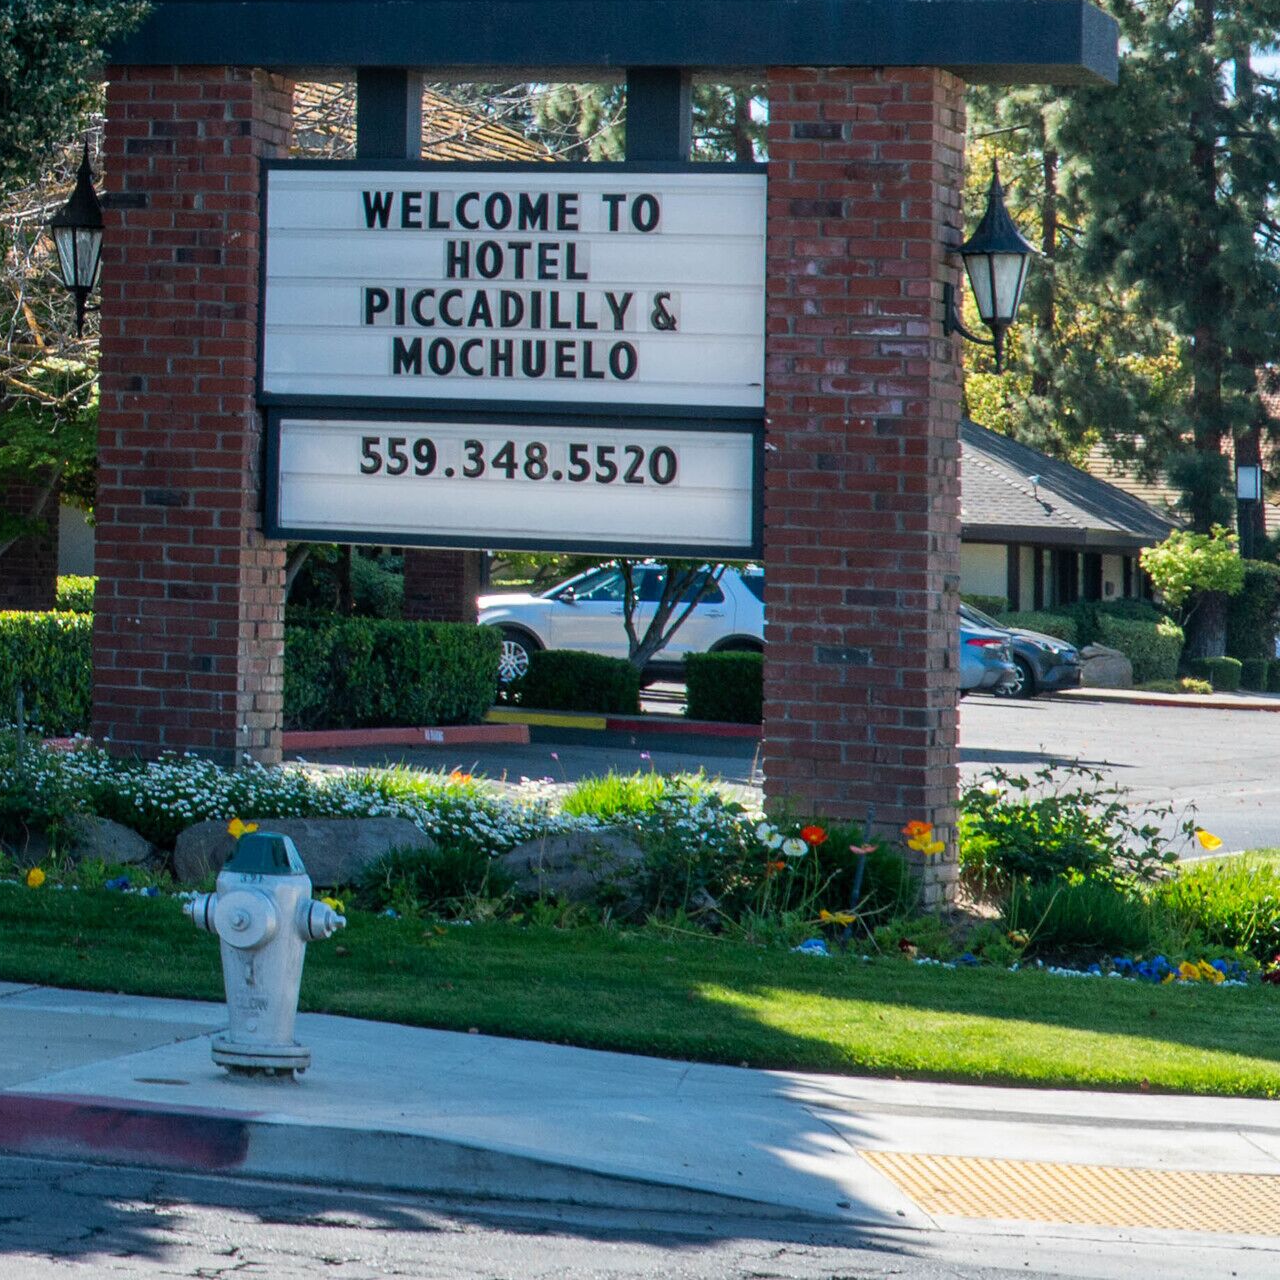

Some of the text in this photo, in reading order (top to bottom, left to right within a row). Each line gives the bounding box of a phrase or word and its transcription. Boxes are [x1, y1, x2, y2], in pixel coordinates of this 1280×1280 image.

[362, 190, 661, 233] WELCOME TO
[446, 240, 589, 281] HOTEL
[365, 287, 678, 331] PICCADILLY &
[392, 336, 638, 381] MOCHUELO
[359, 436, 679, 486] 559.348.5520
